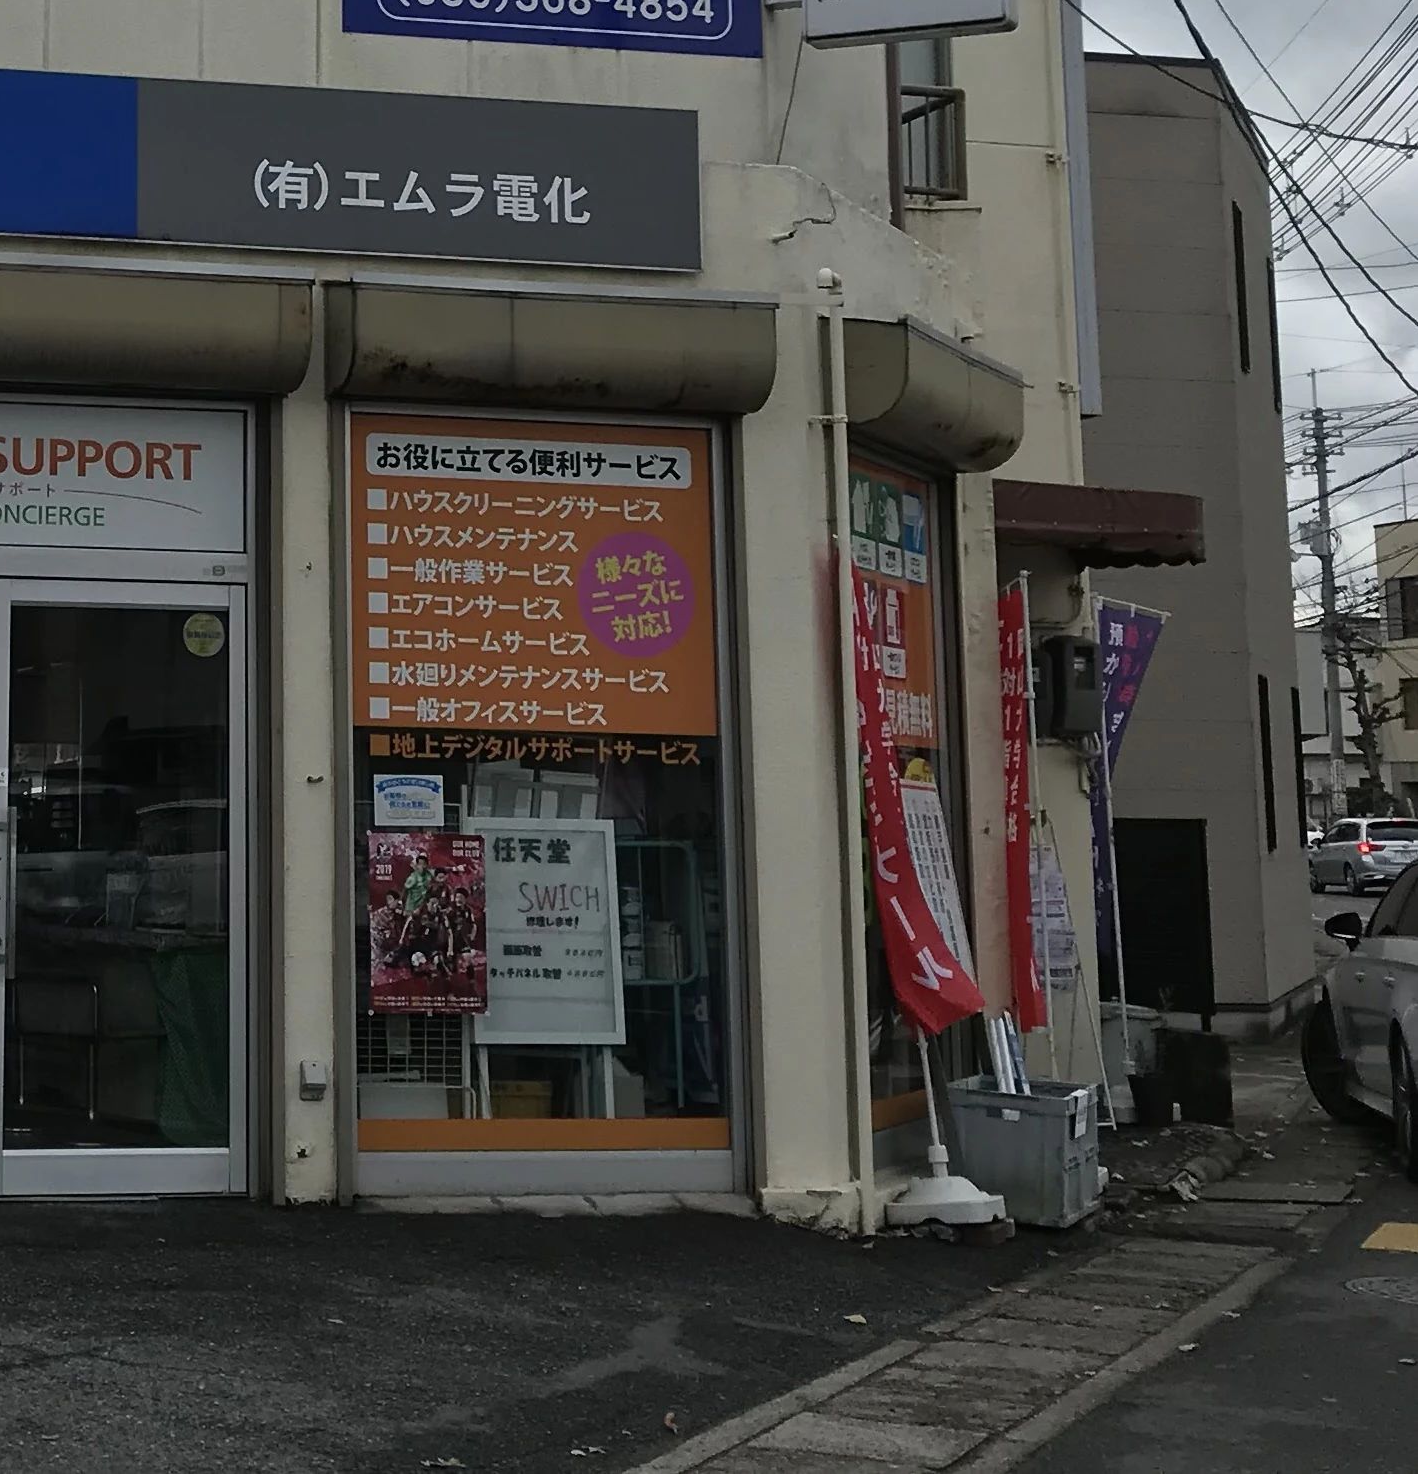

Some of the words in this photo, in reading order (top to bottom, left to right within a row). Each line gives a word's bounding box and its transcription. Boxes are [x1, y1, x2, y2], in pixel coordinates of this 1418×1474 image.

[376, 441, 682, 481] お役に立てる便利サービス
[390, 489, 664, 523] ハウスクリーニングサービス
[390, 524, 580, 553] ハウスメンテナンス
[390, 557, 575, 587] 一般作業サービス
[595, 550, 667, 585] 様々な
[391, 592, 565, 621] エアコンサービス
[591, 578, 685, 614] ニーズに
[391, 627, 591, 656] エコホームサービス
[391, 661, 670, 694] 水廻りメンテナンスサービス
[391, 697, 608, 727] 一般オフィスサービス
[391, 733, 702, 766] 地上デジタルサポートサービス
[493, 836, 572, 865] 任天堂
[517, 881, 601, 914] SWICH
